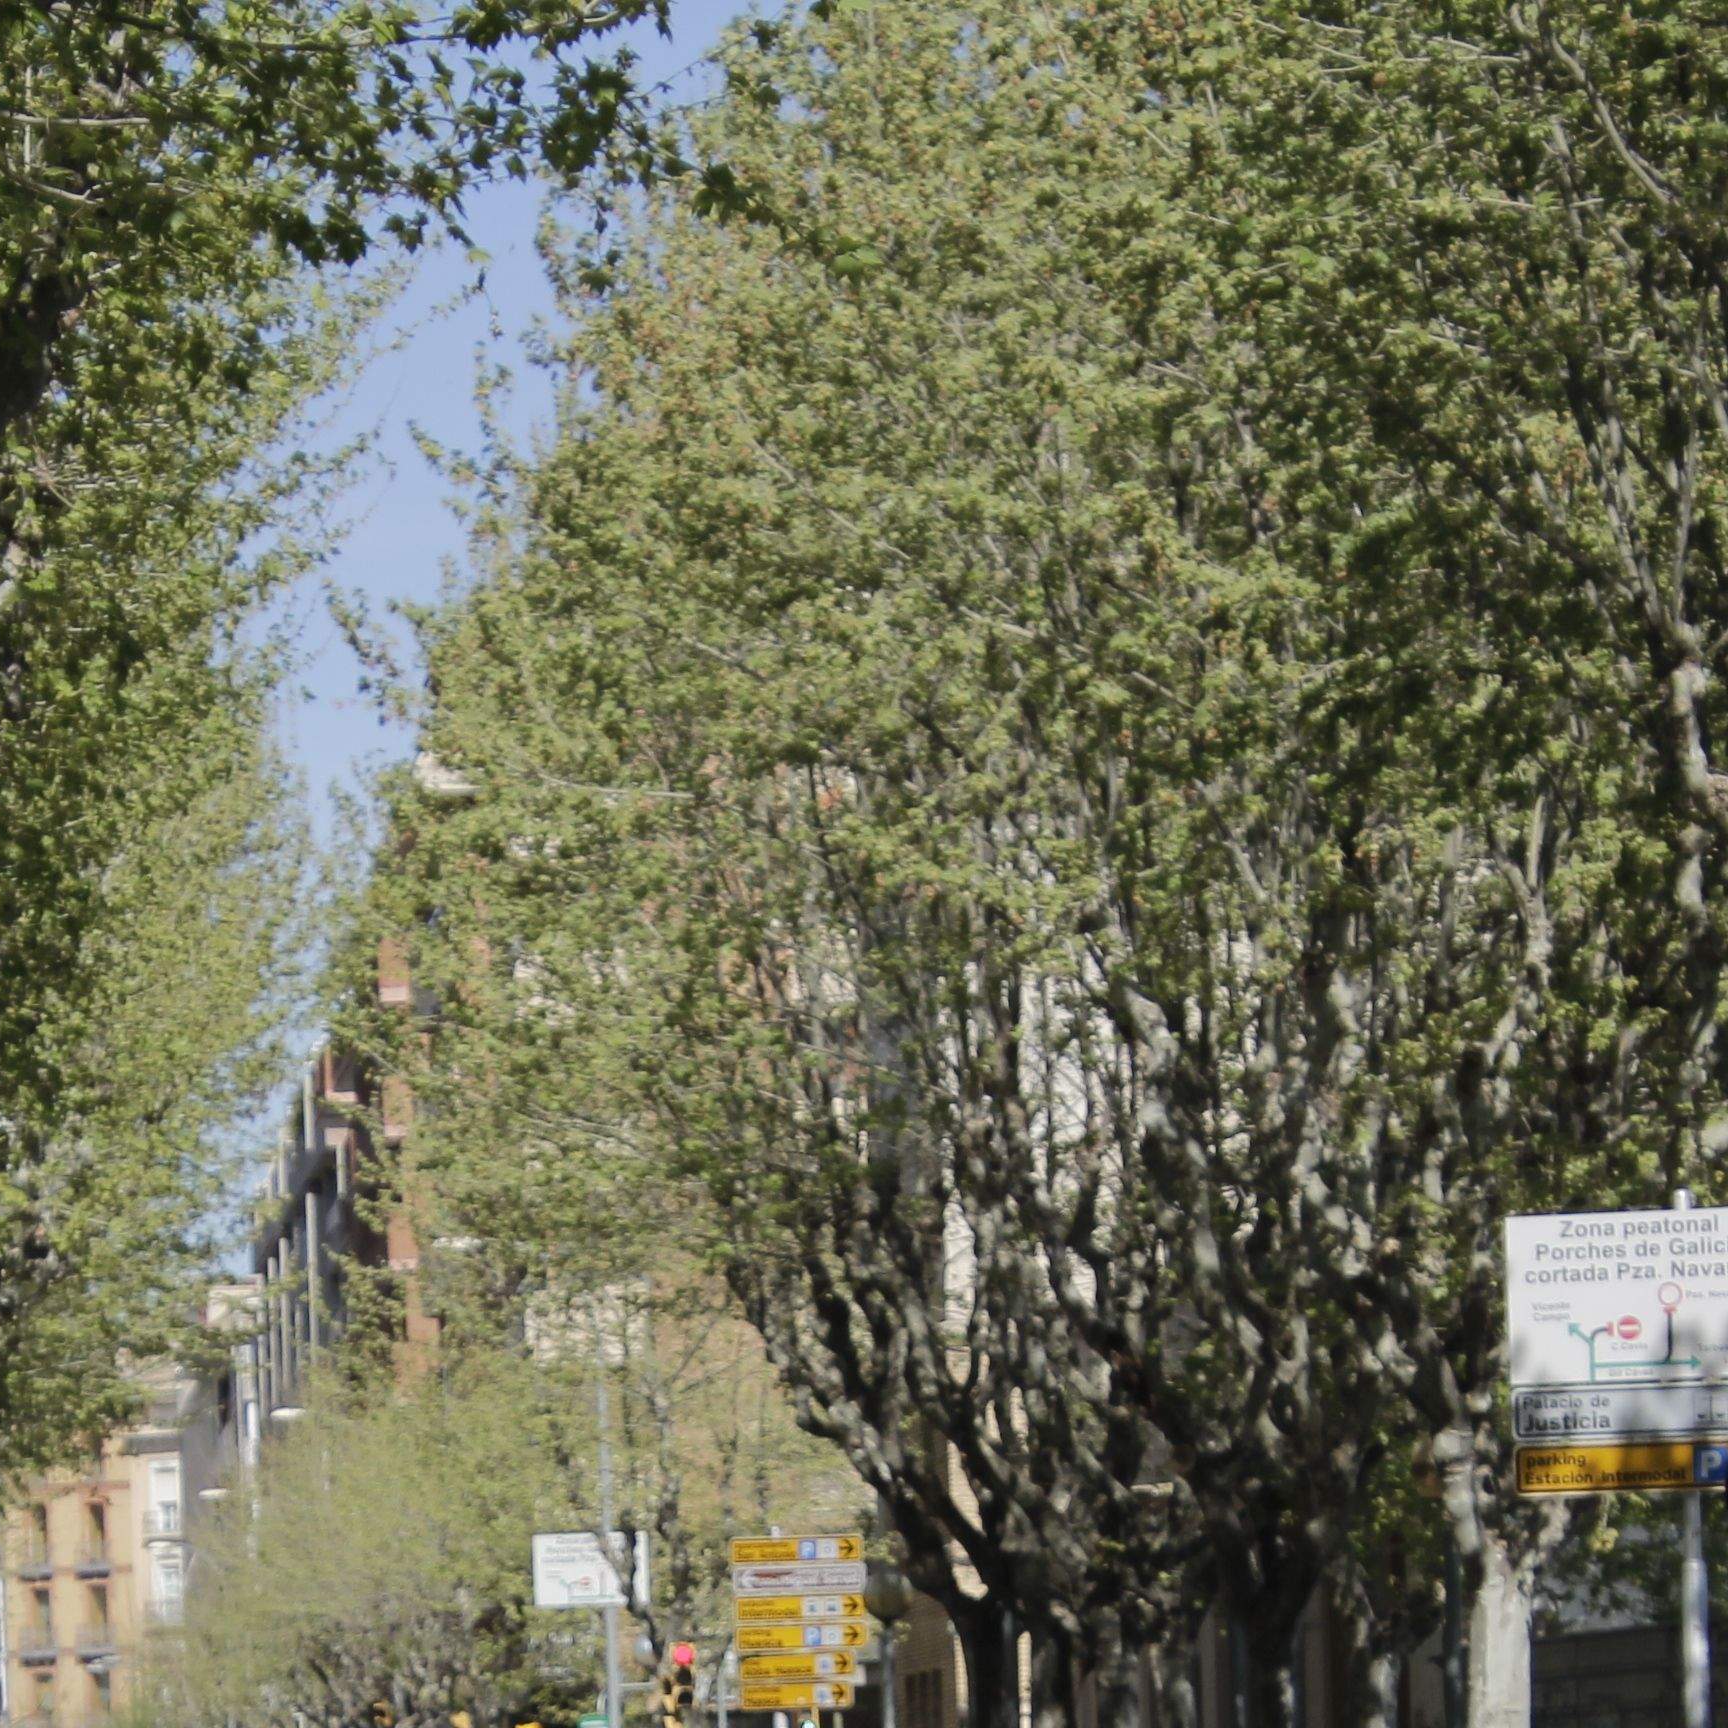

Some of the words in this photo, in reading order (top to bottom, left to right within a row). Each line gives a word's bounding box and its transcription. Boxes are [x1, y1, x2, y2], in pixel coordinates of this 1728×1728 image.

[1559, 1220, 1616, 1238] Zona
[1623, 1213, 1719, 1237] peatonal
[1535, 1243, 1626, 1261] Porches
[1636, 1238, 1661, 1257] de
[1524, 1265, 1609, 1284] cortada
[1617, 1262, 1662, 1279] Pza.
[1523, 1396, 1583, 1410] Palacio
[1591, 1395, 1611, 1408] de
[1524, 1411, 1611, 1431] Justicia
[1526, 1452, 1586, 1468] parking
[1701, 1450, 1722, 1478] P
[1601, 1467, 1687, 1483] intermodal
